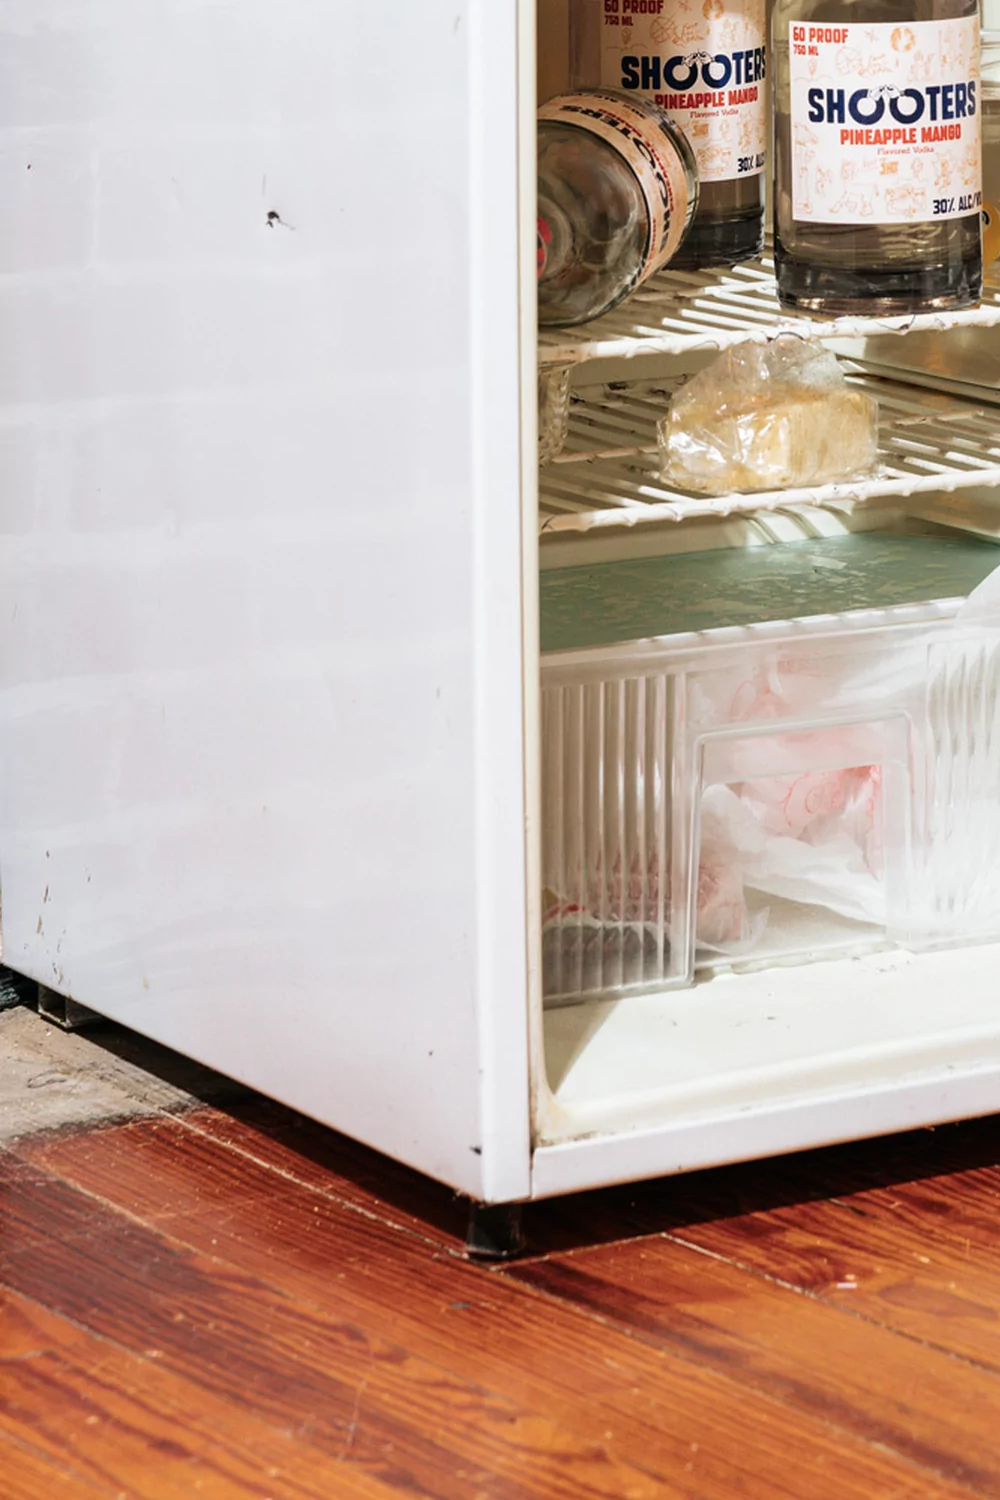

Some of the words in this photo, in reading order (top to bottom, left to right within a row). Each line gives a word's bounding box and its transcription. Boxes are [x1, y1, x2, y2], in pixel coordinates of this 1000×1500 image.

[622, 0, 664, 14] PROOF
[604, 14, 619, 26] 750
[622, 16, 633, 26] ML
[793, 26, 806, 42] 60
[808, 28, 849, 43] PROOF
[793, 44, 807, 56] 750
[808, 45, 819, 56] ML
[621, 45, 766, 91] SHOOTERS
[654, 91, 726, 110] PINEAPPLE
[727, 86, 758, 106] MANGO
[808, 81, 976, 125] SHOOTERS
[840, 127, 917, 146] PINEAPPLE
[921, 124, 962, 143] MANGO
[933, 197, 955, 214] 30%
